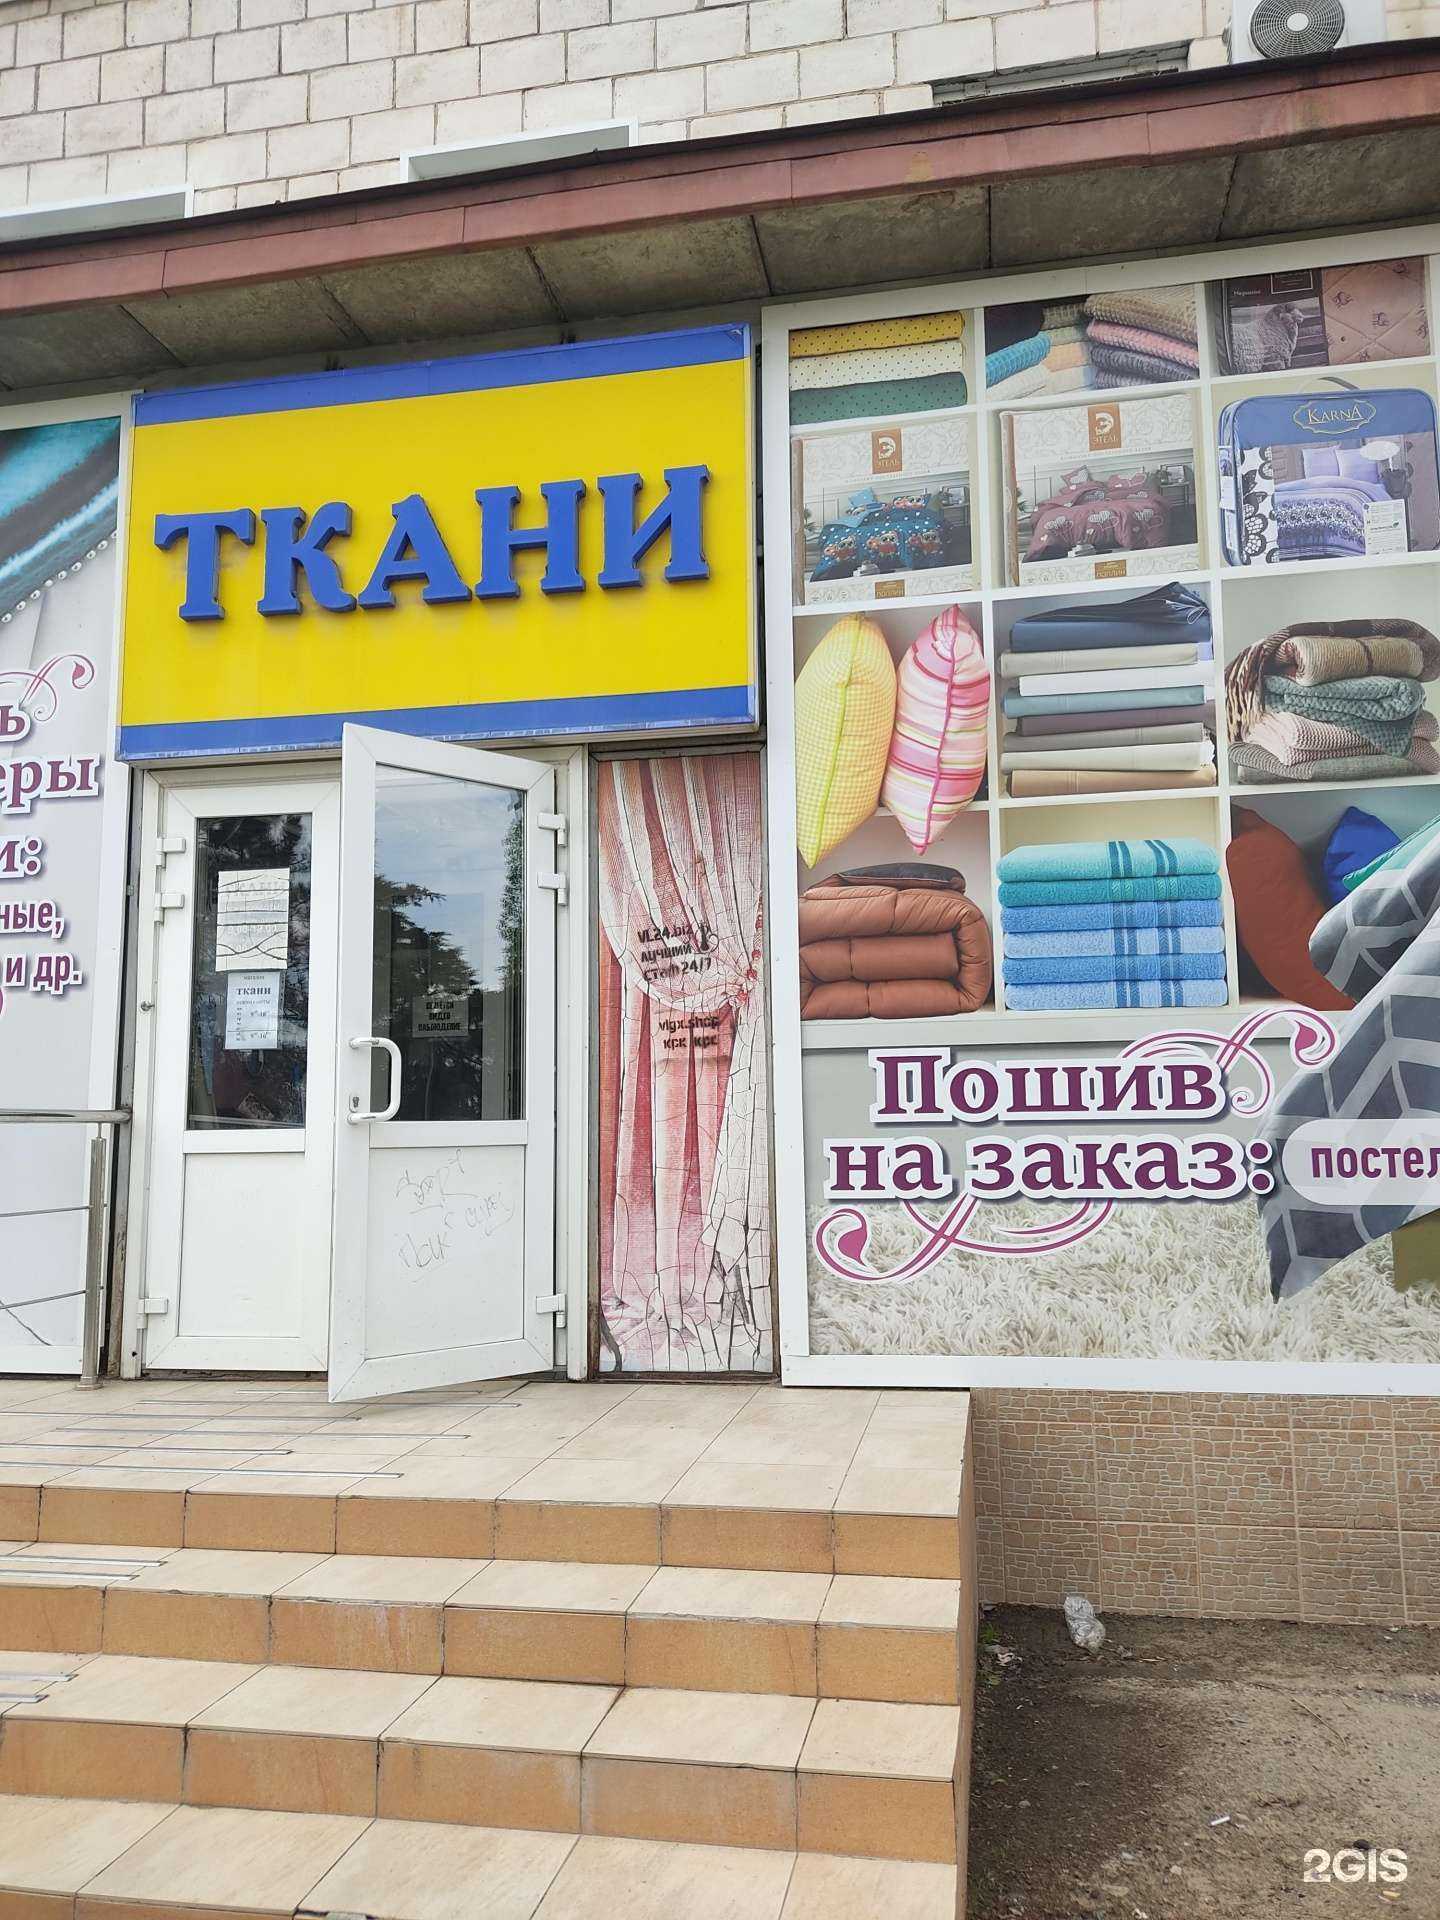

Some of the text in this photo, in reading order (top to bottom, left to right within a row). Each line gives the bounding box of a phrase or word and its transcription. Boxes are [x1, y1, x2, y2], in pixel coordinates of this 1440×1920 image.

[1308, 404, 1364, 424] KARNA
[154, 464, 711, 622] ТКАНИ
[5, 955, 80, 991] и др.
[681, 957, 711, 974] 24/7
[876, 1054, 1219, 1116] Пошив
[830, 1138, 1272, 1193] на заказ:
